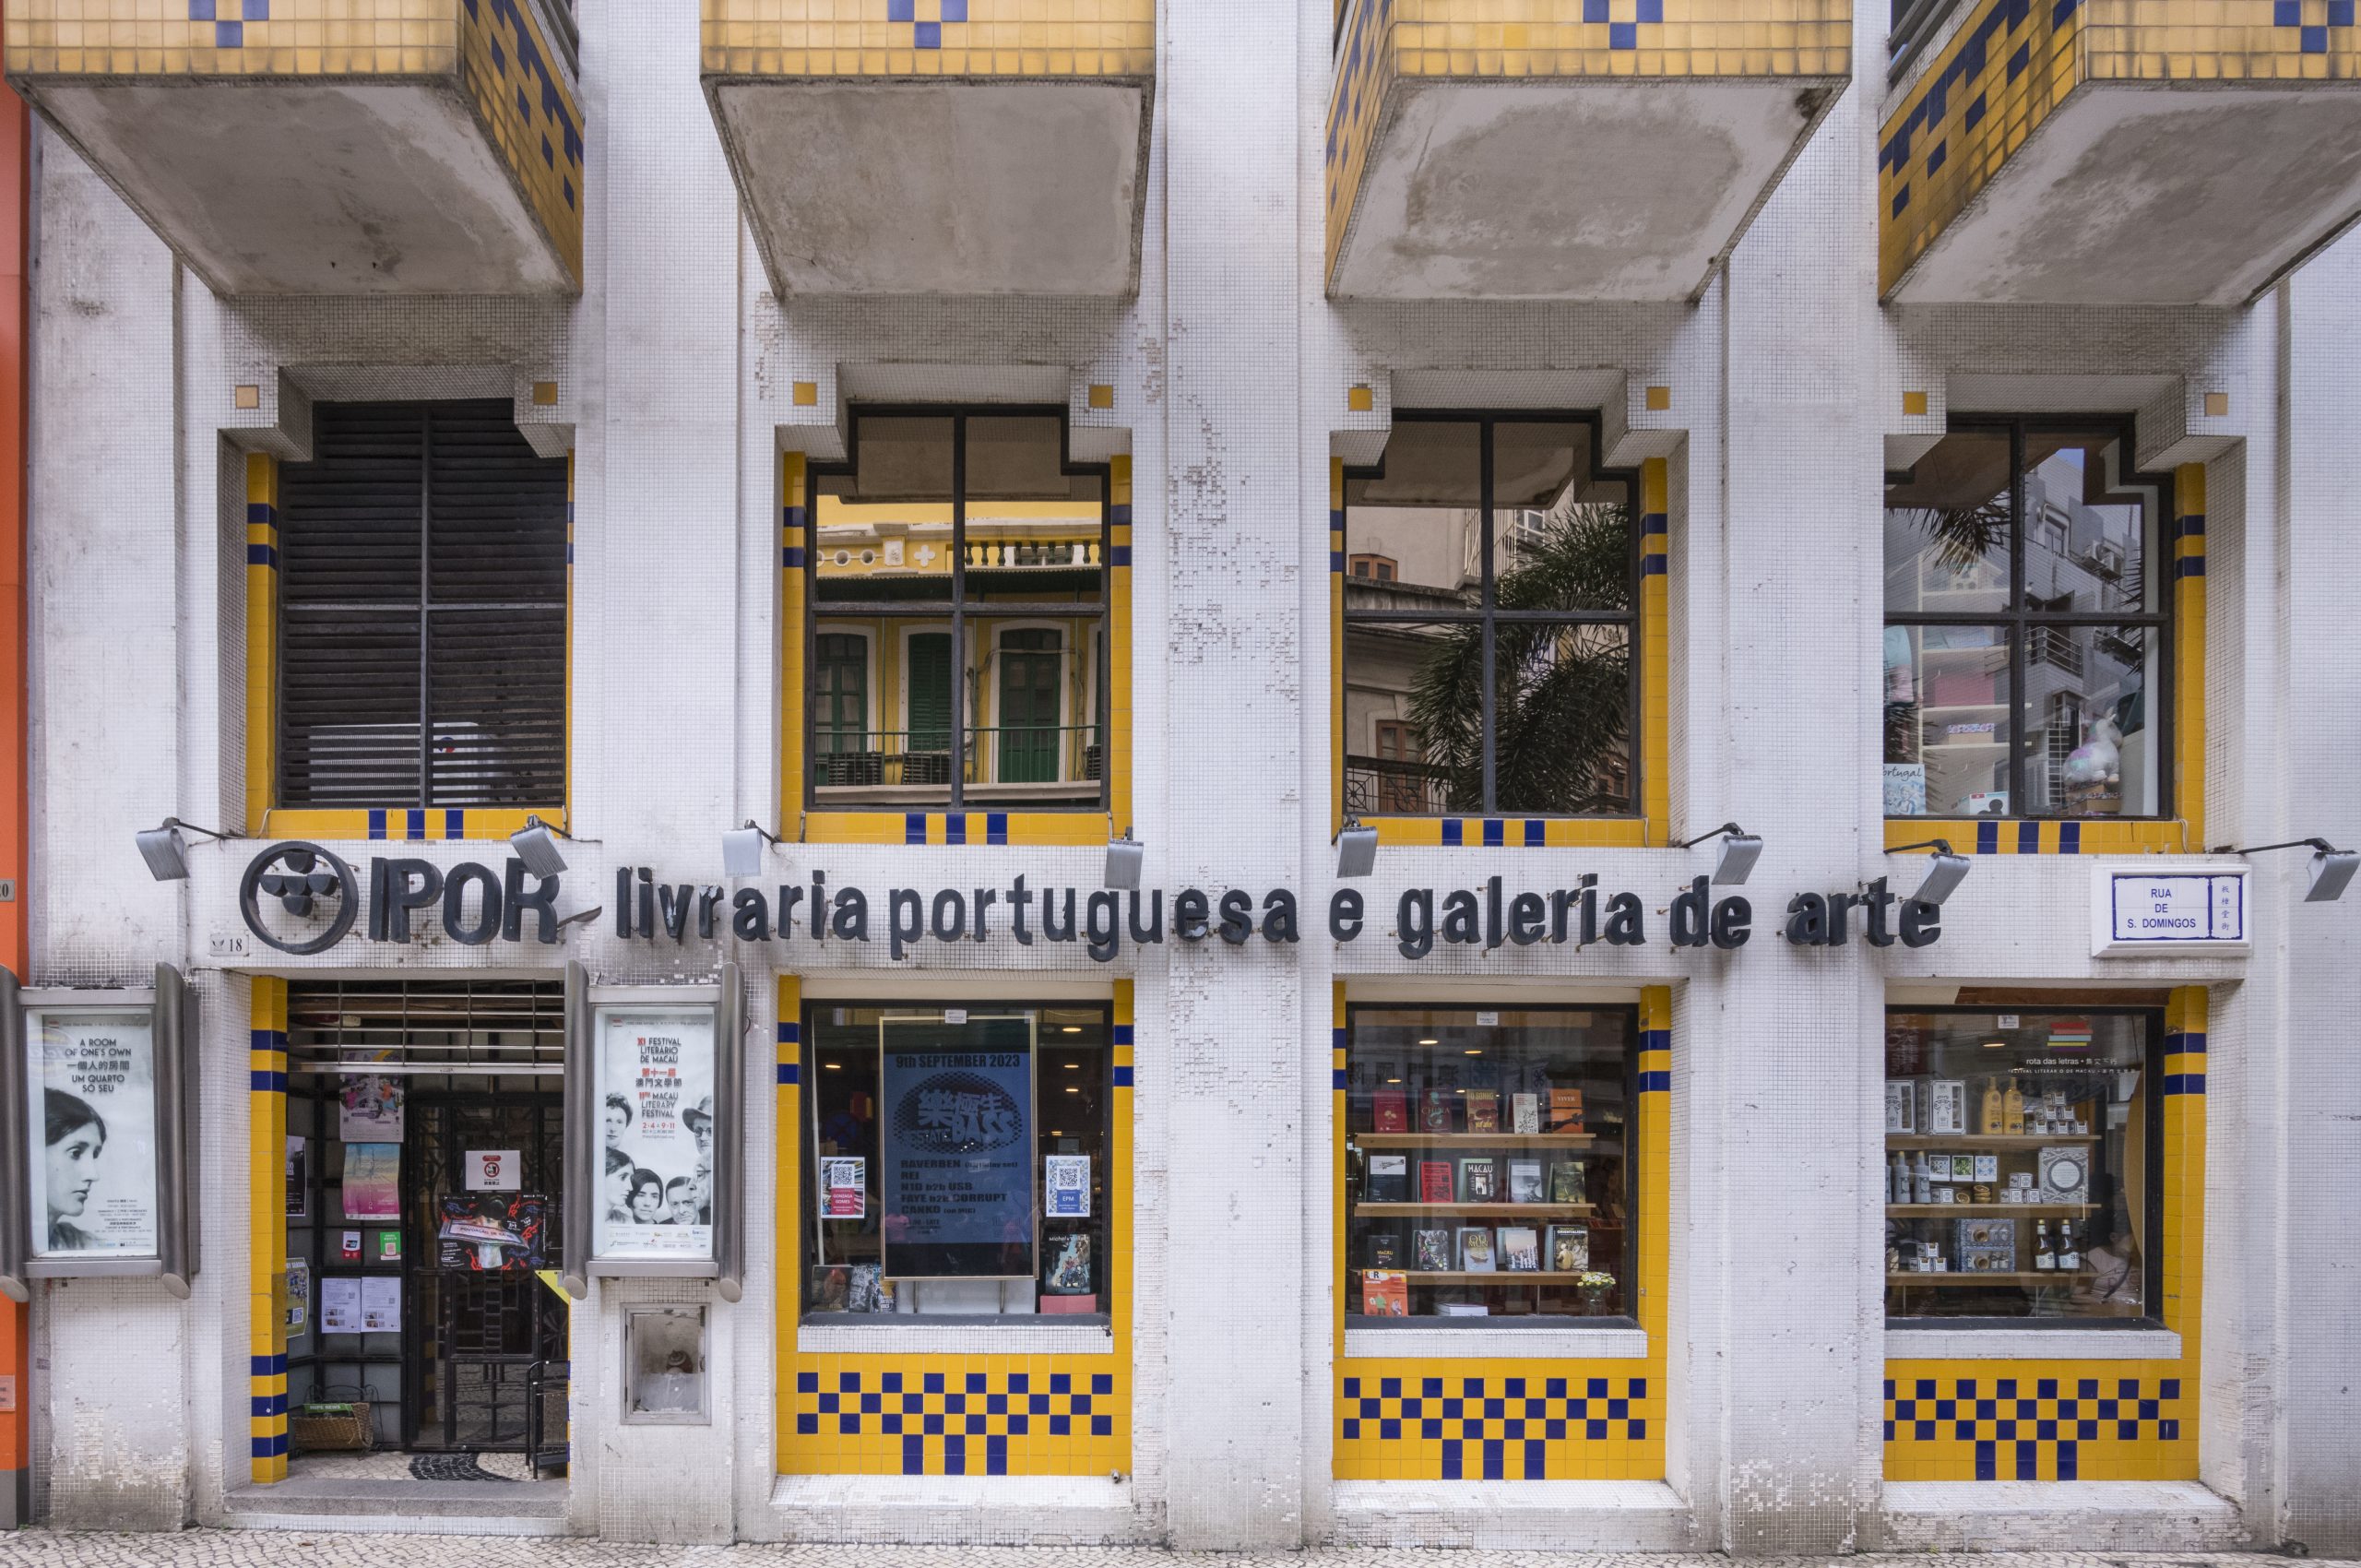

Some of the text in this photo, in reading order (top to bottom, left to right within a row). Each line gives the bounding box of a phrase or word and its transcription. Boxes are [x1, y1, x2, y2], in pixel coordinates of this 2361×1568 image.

[0, 883, 9, 897] 0
[2151, 889, 2172, 898] RUA
[371, 857, 560, 945] IPOR
[2154, 904, 2168, 913] DE
[616, 866, 1941, 962] livraria portuguesa e galeria de arte
[2127, 919, 2196, 928] S. DOMINGOS
[230, 938, 243, 952] 18
[637, 1038, 682, 1046] XI FESTIVAL
[80, 1048, 106, 1056] ONE'S
[109, 1048, 132, 1056] OWN
[640, 1055, 678, 1063] DE MACAU
[896, 1054, 1020, 1068] 9th SEPTEMBER 2023
[72, 1075, 125, 1083] UM QUARTO
[642, 1110, 674, 1118] FESTIVAL
[1467, 1164, 1493, 1173] MACAU
[900, 1171, 919, 1180] REI
[952, 1194, 1007, 1202] CORRUPT
